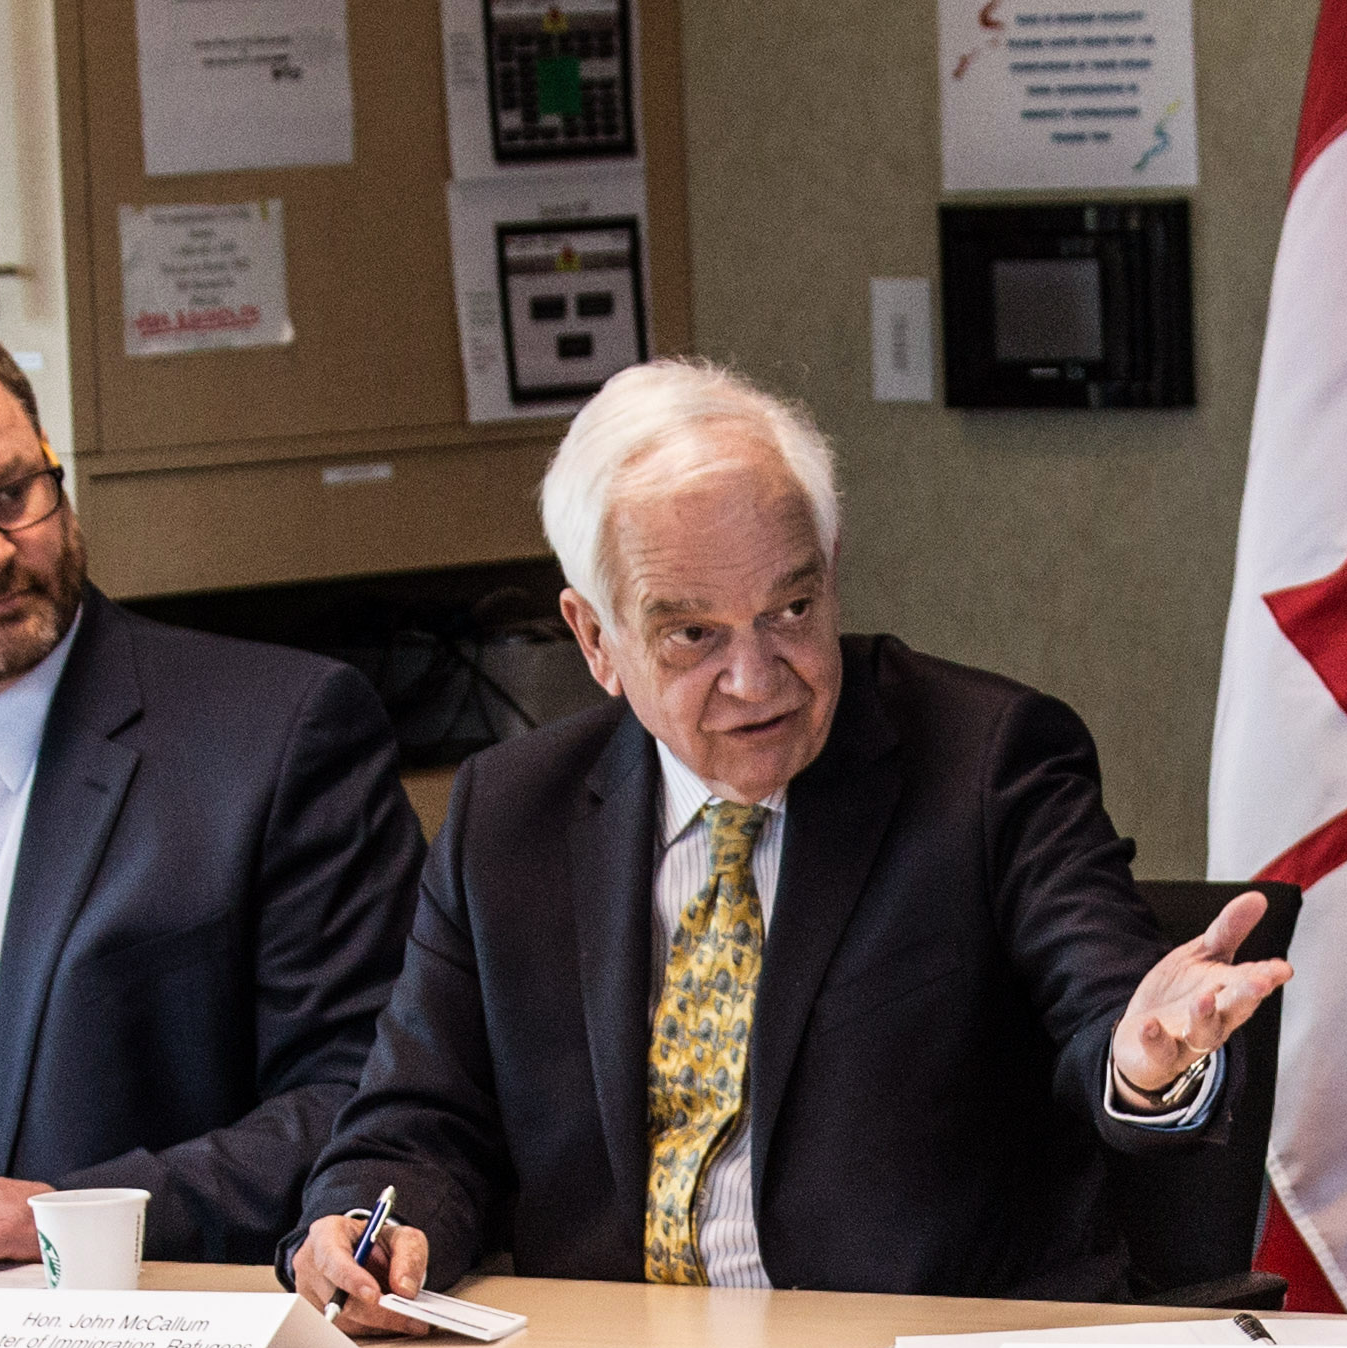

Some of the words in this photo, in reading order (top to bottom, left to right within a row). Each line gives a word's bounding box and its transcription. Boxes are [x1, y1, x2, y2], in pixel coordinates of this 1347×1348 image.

[22, 1312, 63, 1328] Hon.
[69, 1313, 115, 1329] John
[118, 1314, 211, 1332] McCallum
[26, 1334, 51, 1348] of
